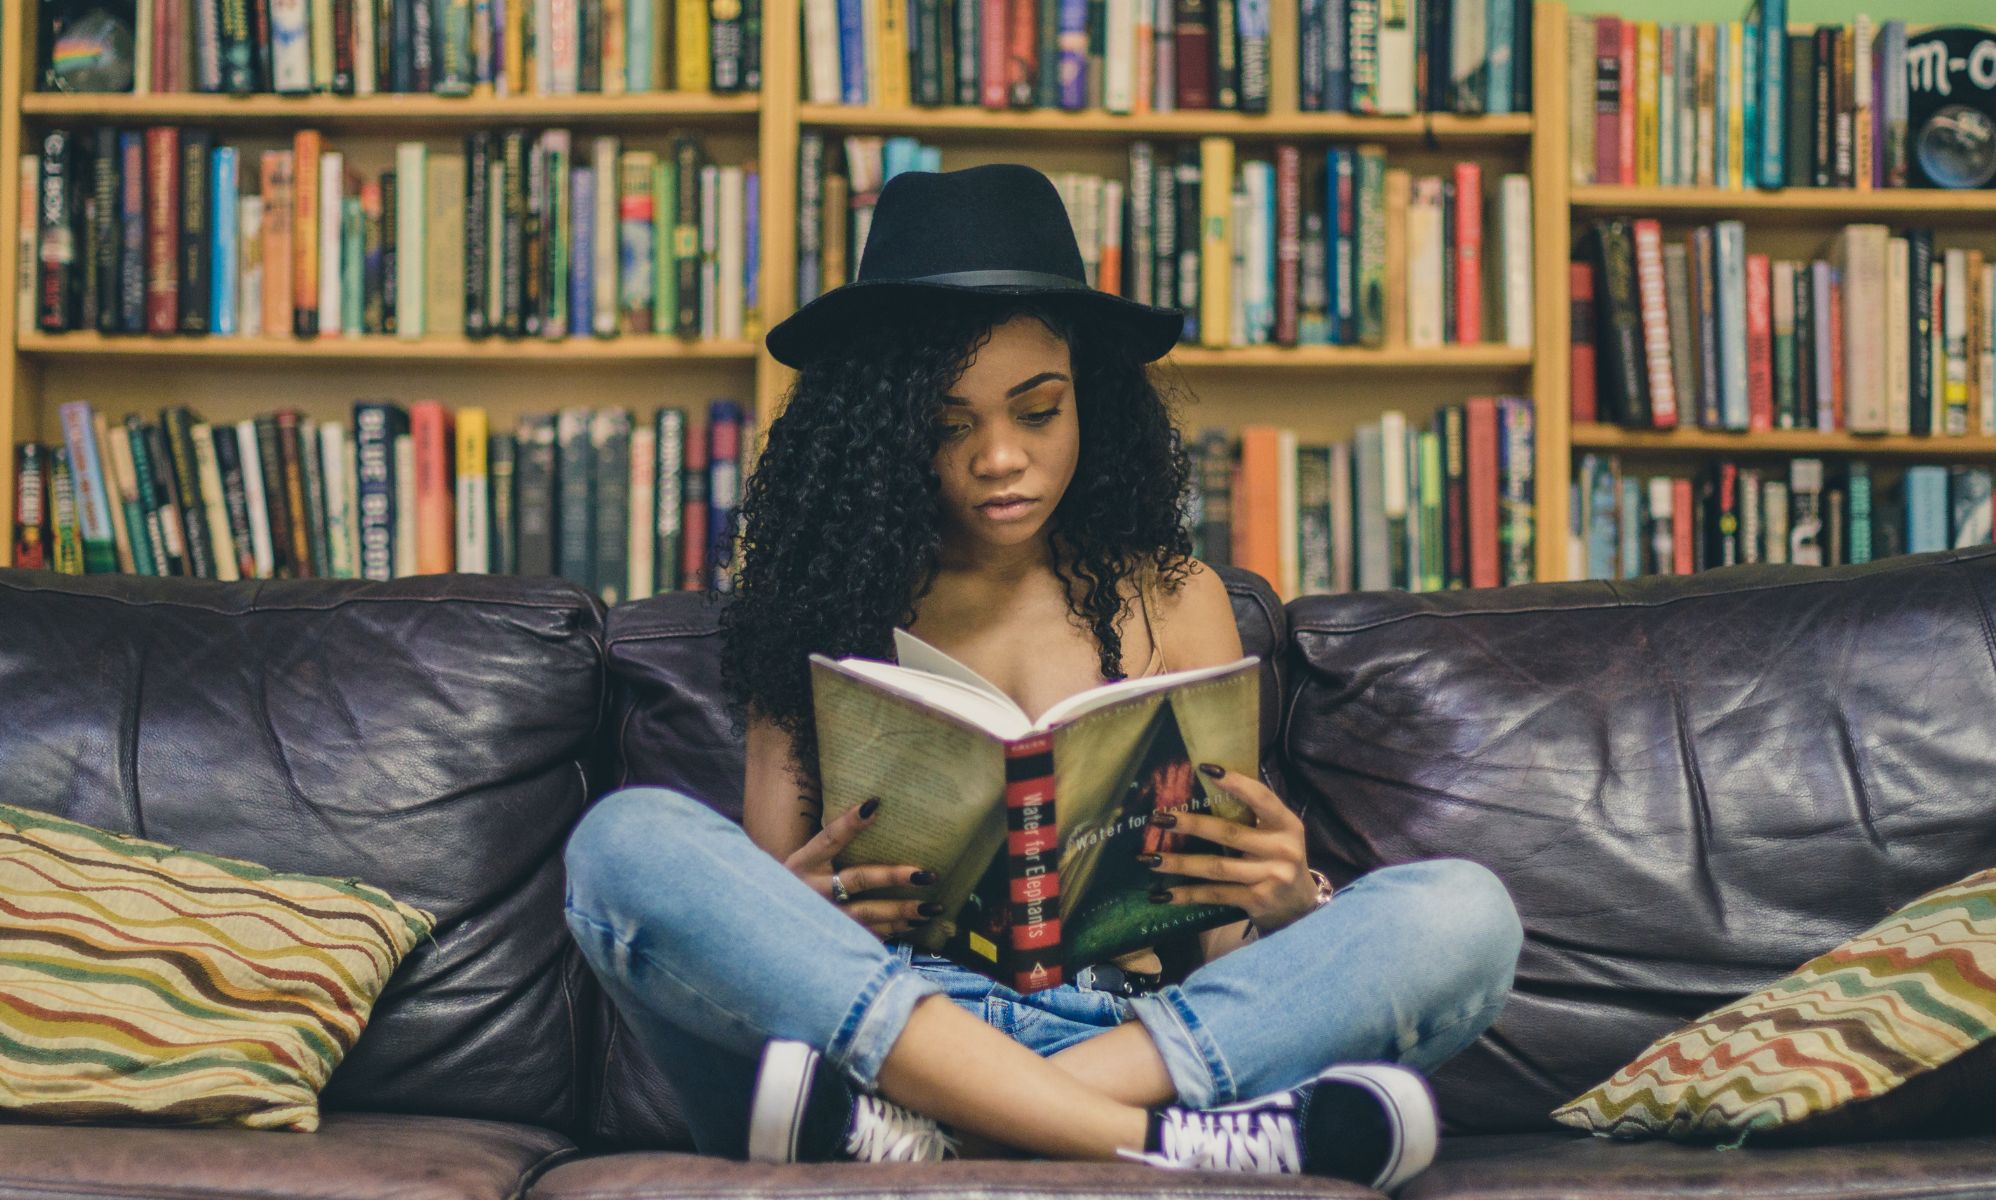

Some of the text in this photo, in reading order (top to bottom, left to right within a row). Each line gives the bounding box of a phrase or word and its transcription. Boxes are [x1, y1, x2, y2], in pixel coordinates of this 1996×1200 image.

[358, 408, 386, 482] BLUE
[1076, 823, 1122, 850] Water
[1128, 814, 1147, 829] for
[1023, 792, 1047, 938] Water for Elephants
[1140, 919, 1179, 936] SARA
